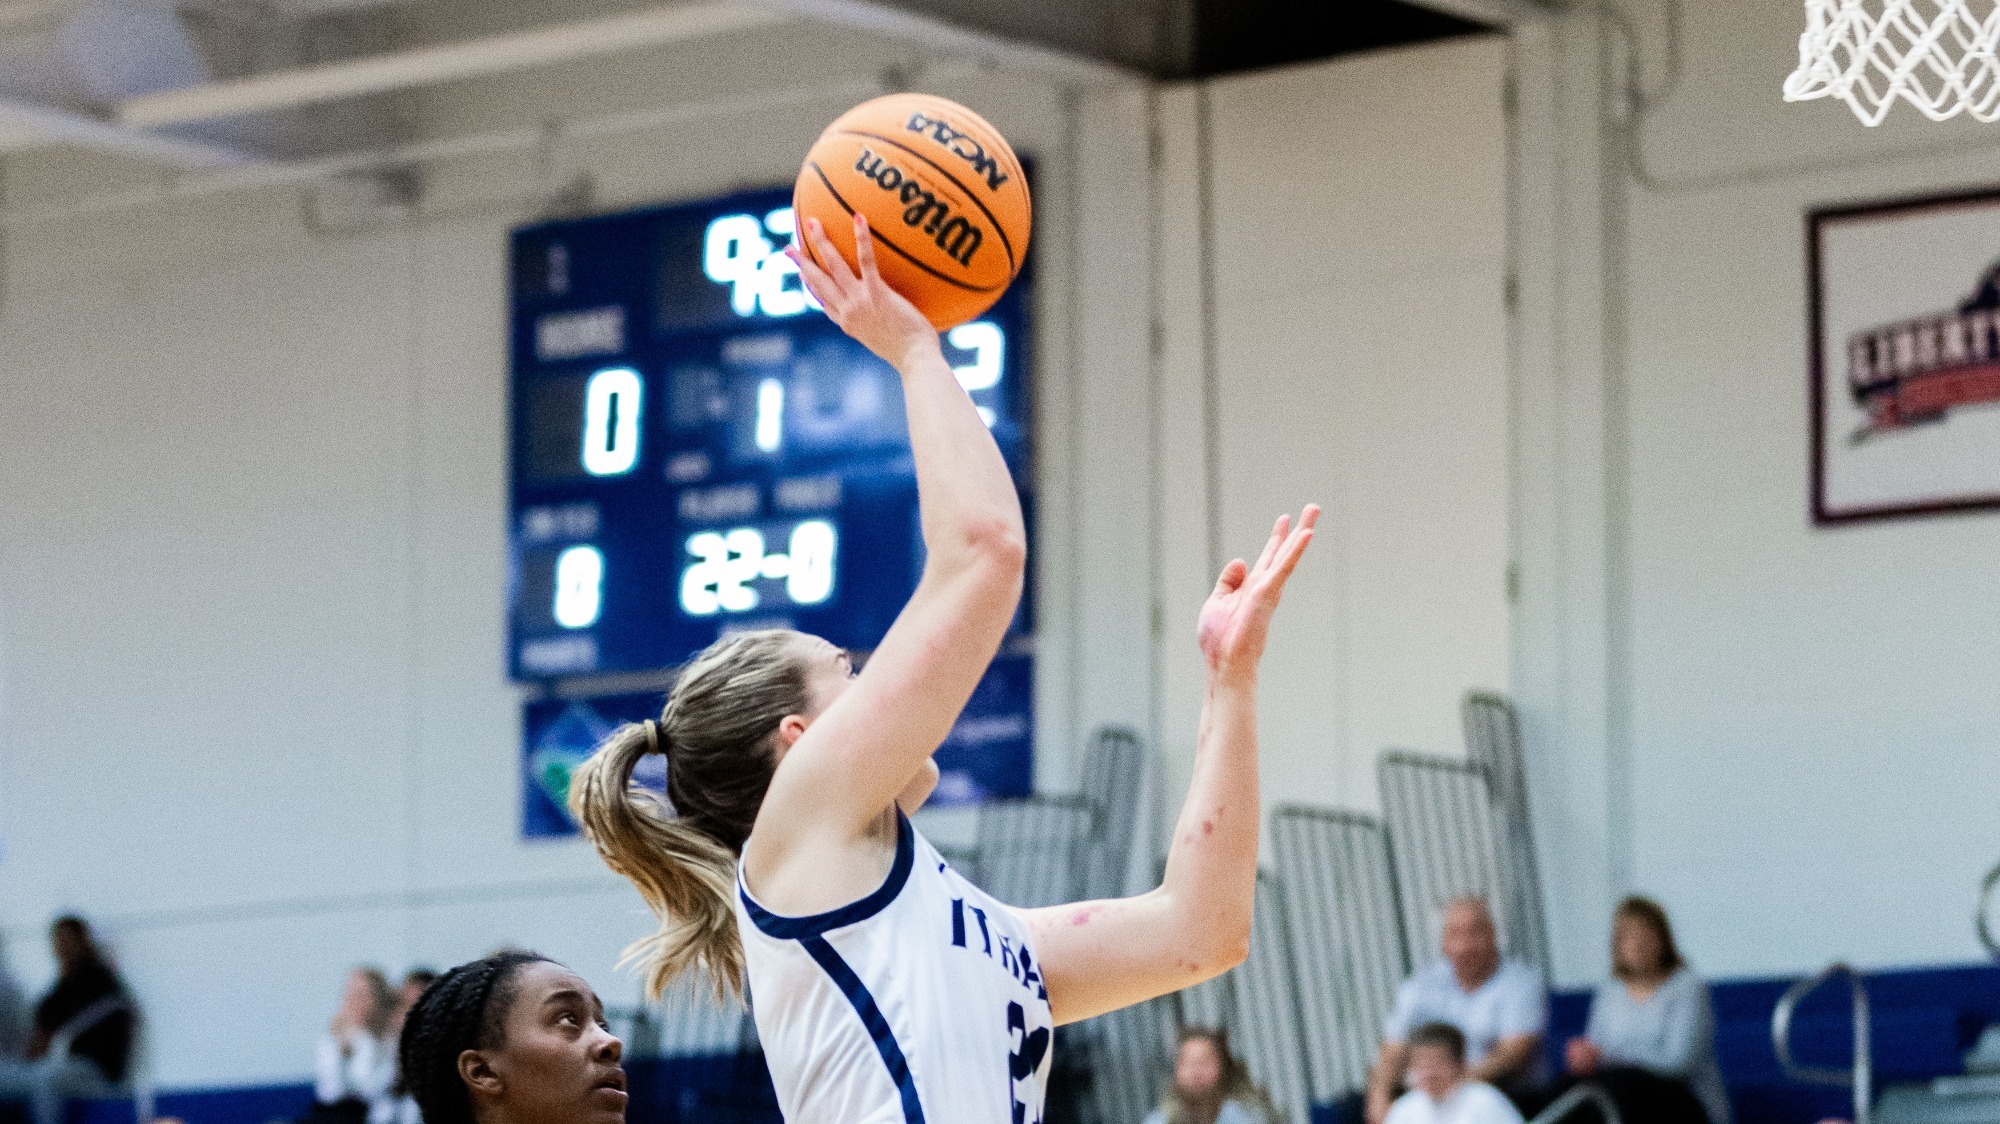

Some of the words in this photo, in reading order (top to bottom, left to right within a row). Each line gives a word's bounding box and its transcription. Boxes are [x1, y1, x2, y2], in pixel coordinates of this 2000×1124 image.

[905, 112, 1009, 192] NCAA
[855, 149, 983, 268] Wilson
[582, 368, 641, 475] 0
[756, 379, 783, 453] 1
